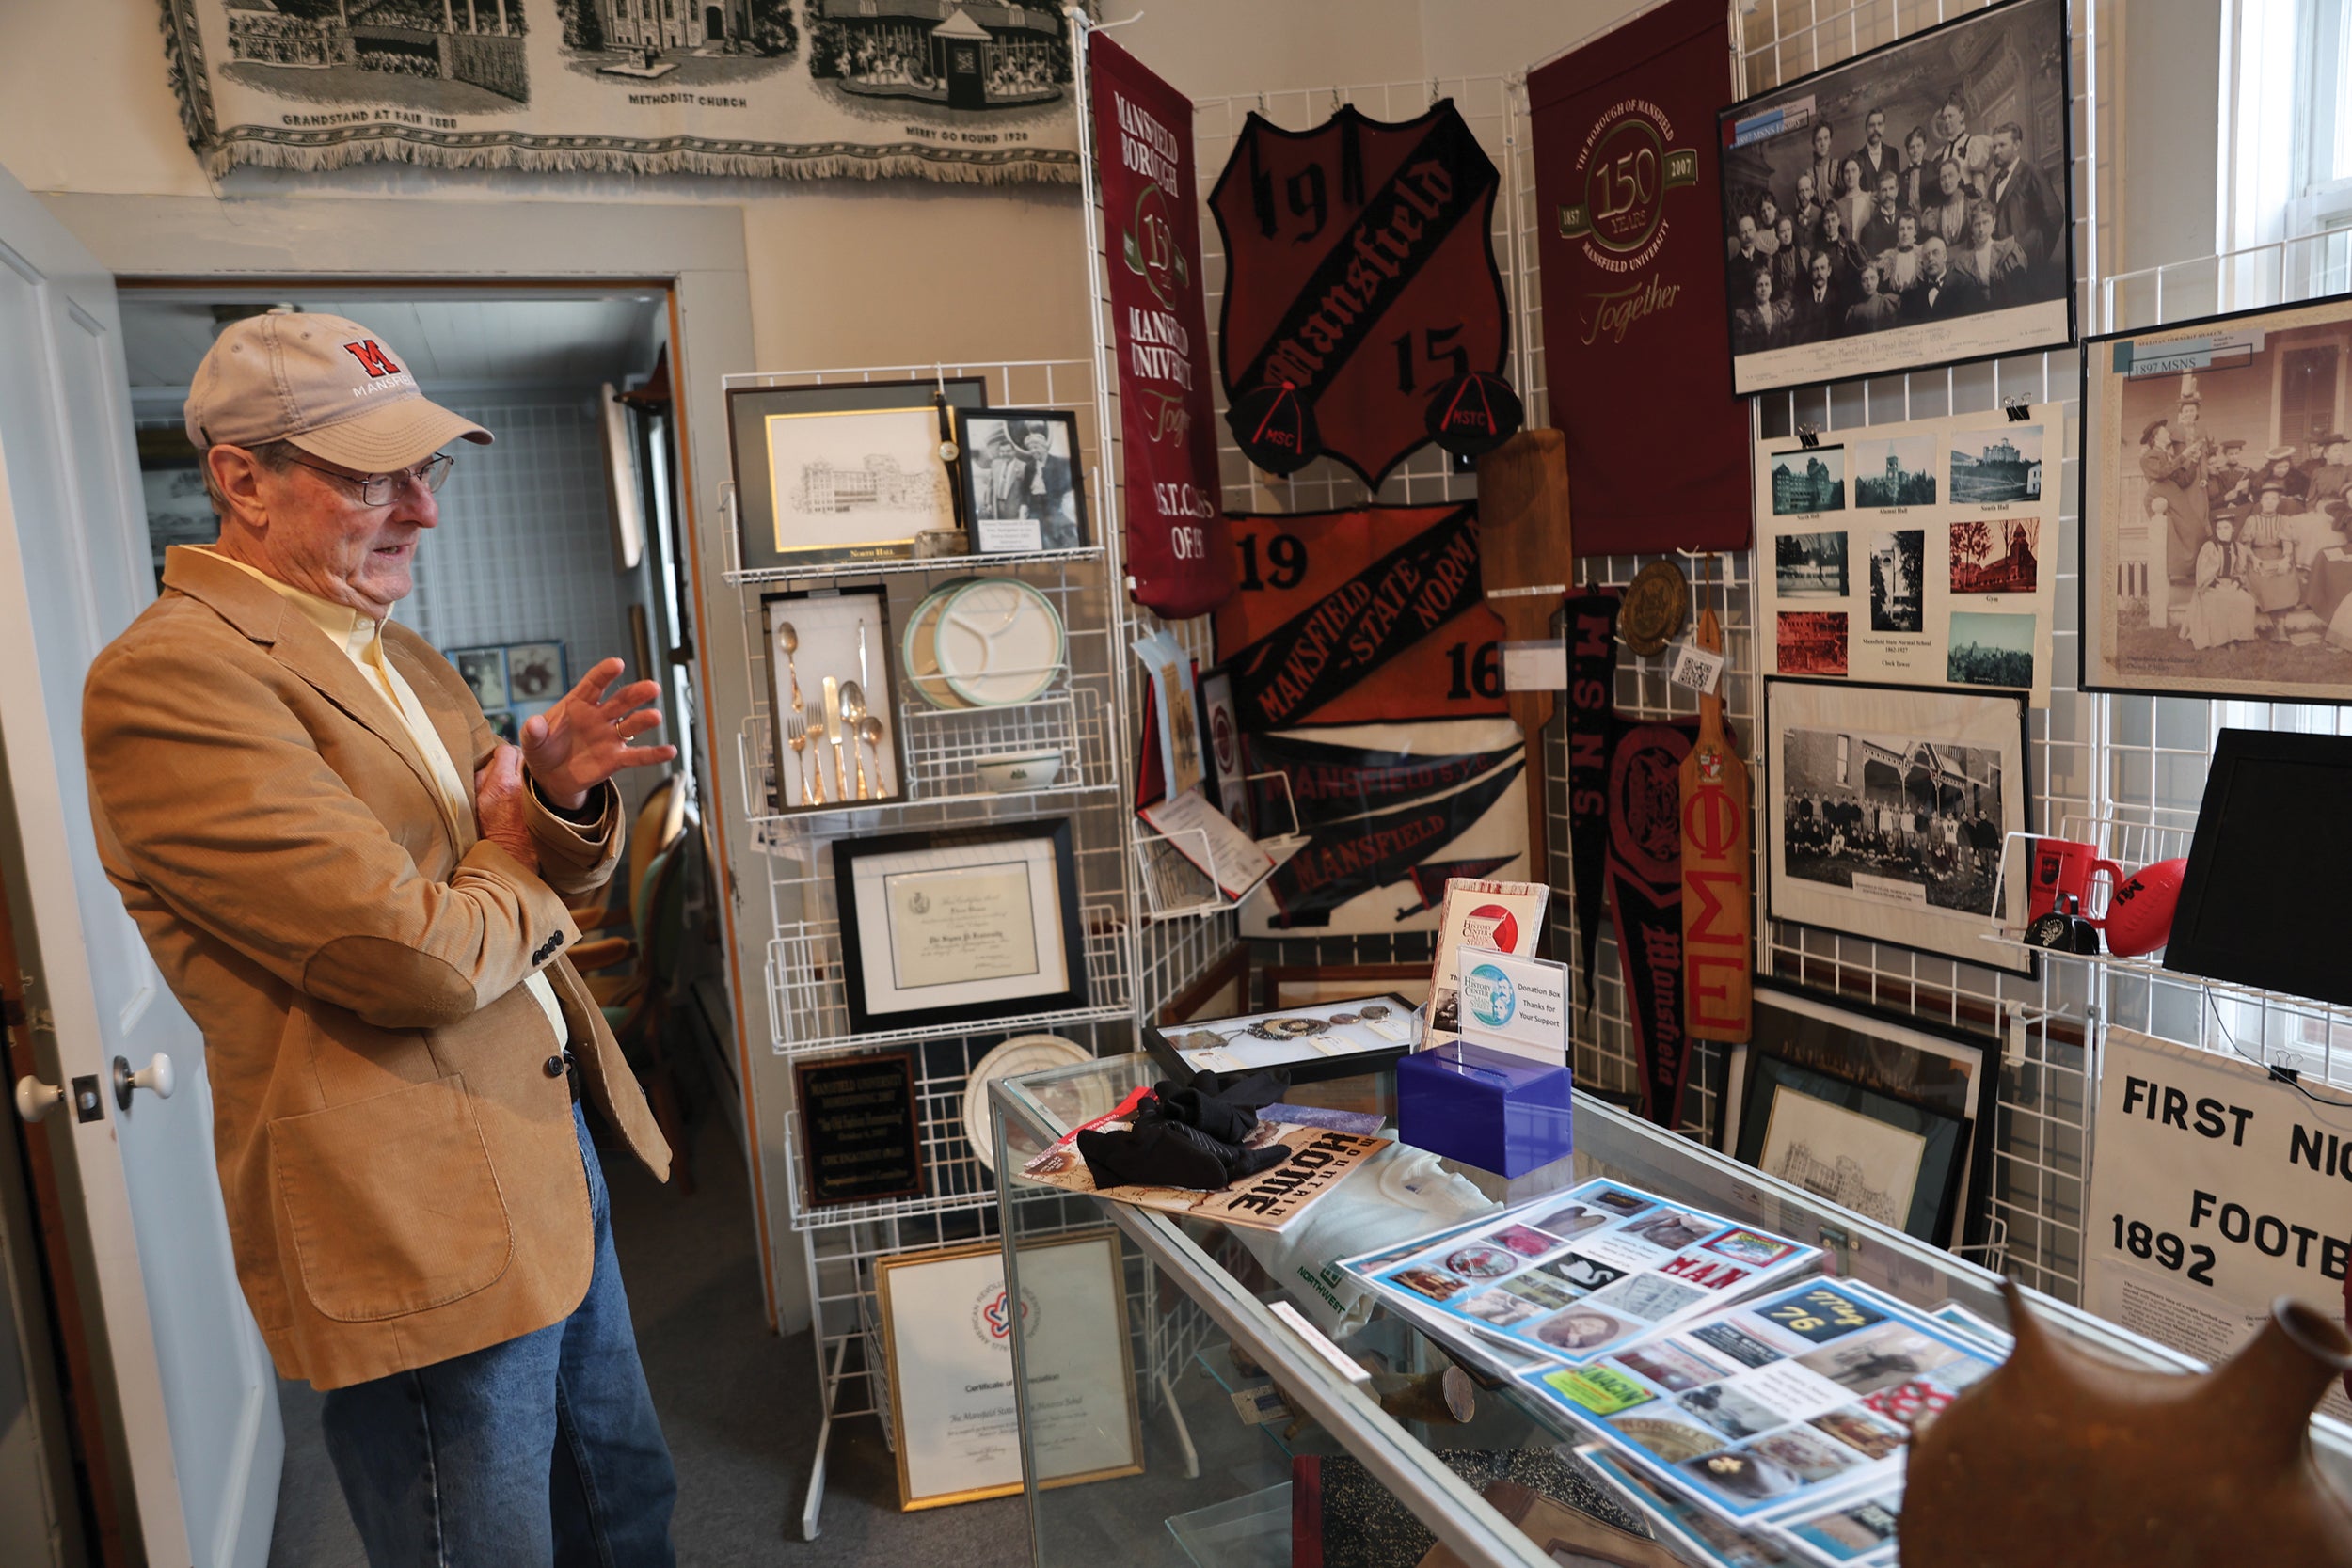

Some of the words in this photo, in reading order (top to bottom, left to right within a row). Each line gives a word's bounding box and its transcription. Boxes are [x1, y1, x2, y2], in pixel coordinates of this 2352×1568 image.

[628, 93, 694, 105] METHODIST
[699, 95, 747, 108] CHURCH
[282, 110, 369, 126] GRANDSTAND
[374, 109, 390, 120] AT
[395, 110, 422, 124] FAIR
[905, 126, 937, 139] MERRY
[941, 131, 957, 141] GO
[961, 133, 998, 144] ROUND
[1575, 151, 1588, 171] THE
[1587, 102, 1626, 149] BOROUGH
[1624, 99, 1637, 113] OF
[1637, 99, 1675, 142] MANSFIELD
[1670, 159, 1692, 177] 2007
[1596, 148, 1656, 219] 150
[1611, 210, 1647, 234] YEARS
[1582, 241, 1629, 273] MANSFIELD
[1629, 219, 1670, 272] UNIVERSITY
[1581, 273, 1681, 346] Together
[343, 339, 402, 379] M
[2135, 362, 2160, 375] 1897
[2160, 357, 2197, 372] MSNS
[352, 375, 417, 398] MANSFIE
[1453, 410, 1486, 427] MSTC
[1265, 428, 1295, 448] MSC
[1234, 533, 1308, 592] 19
[1415, 517, 1481, 633] NORMA
[1257, 580, 1373, 723] MANSFIELD
[1447, 641, 1509, 701] 16
[1263, 762, 1435, 802] MANSFIELD
[1291, 814, 1446, 893] MANSFIELD
[1462, 928, 1490, 938] CENTER
[1463, 919, 1491, 931] HISTORY
[1464, 976, 1491, 991] HISTORY
[1464, 987, 1489, 997] CENTER
[1518, 983, 1547, 996] Donation
[1548, 990, 1561, 998] Box
[1470, 1001, 1490, 1011] STREET
[1474, 996, 1490, 1005] MAIN
[1523, 999, 1545, 1011] Thanks
[1546, 1005, 1556, 1013] for
[1639, 919, 1681, 1087] Mansfield
[1519, 1011, 1534, 1021] Your
[1534, 1016, 1560, 1027] Support
[2122, 1075, 2254, 1147] FIRST
[1227, 1132, 1359, 1215] HOME
[2112, 1213, 2216, 1287] 1892
[977, 1280, 1005, 1302] REVOLU
[1296, 1266, 1346, 1314] NORTHWEST
[971, 1304, 990, 1345] AMERICAN
[1770, 1306, 1826, 1331] 76
[965, 1380, 1004, 1393] Certificate
[1622, 1418, 1701, 1449] NORMAL
